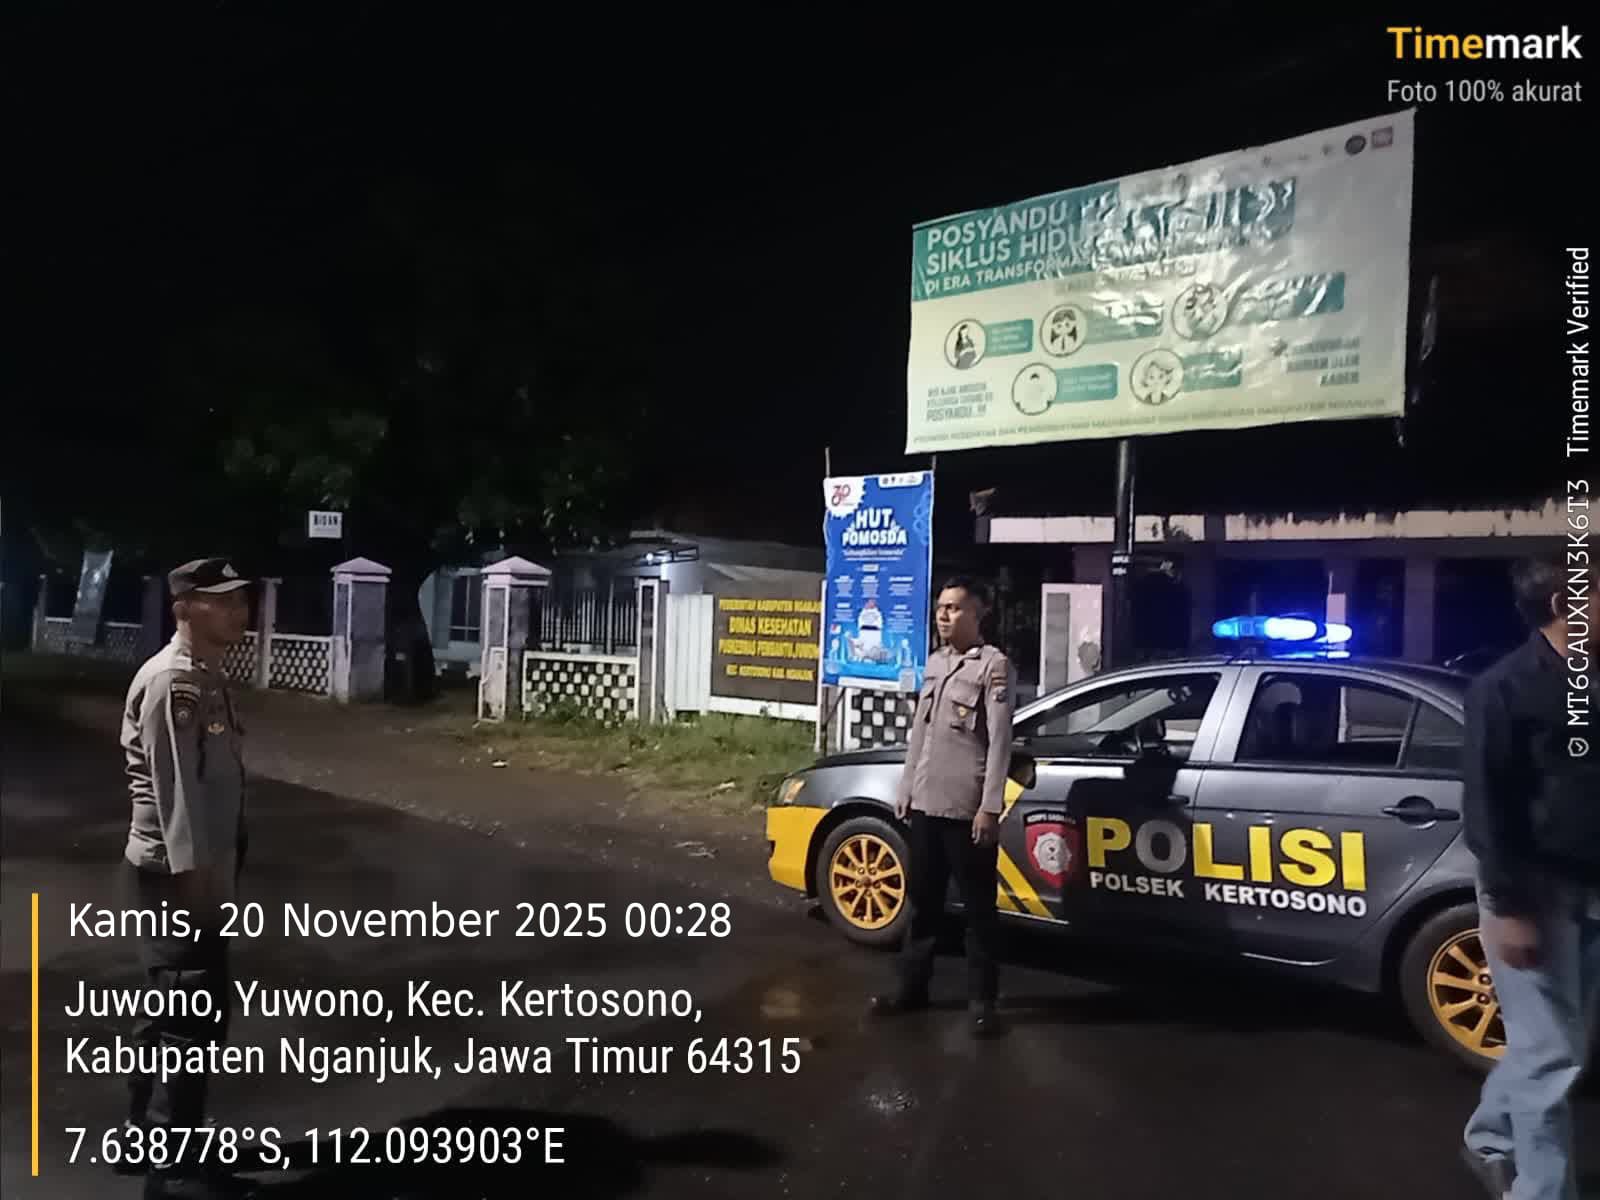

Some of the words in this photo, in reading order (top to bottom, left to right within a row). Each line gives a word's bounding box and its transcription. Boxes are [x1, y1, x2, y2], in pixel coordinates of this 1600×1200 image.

[927, 199, 1067, 250] POSYANDU
[926, 237, 1011, 276] SIKLUS
[943, 273, 972, 292] ERA
[856, 507, 893, 529] HUT
[842, 529, 908, 546] POMOSDA
[728, 615, 756, 634] DINAS
[757, 616, 812, 636] KESEHATAN
[1086, 816, 1366, 892] POLISI
[1090, 871, 1185, 898] POLSEK
[1204, 882, 1367, 918] KERTOSONO
